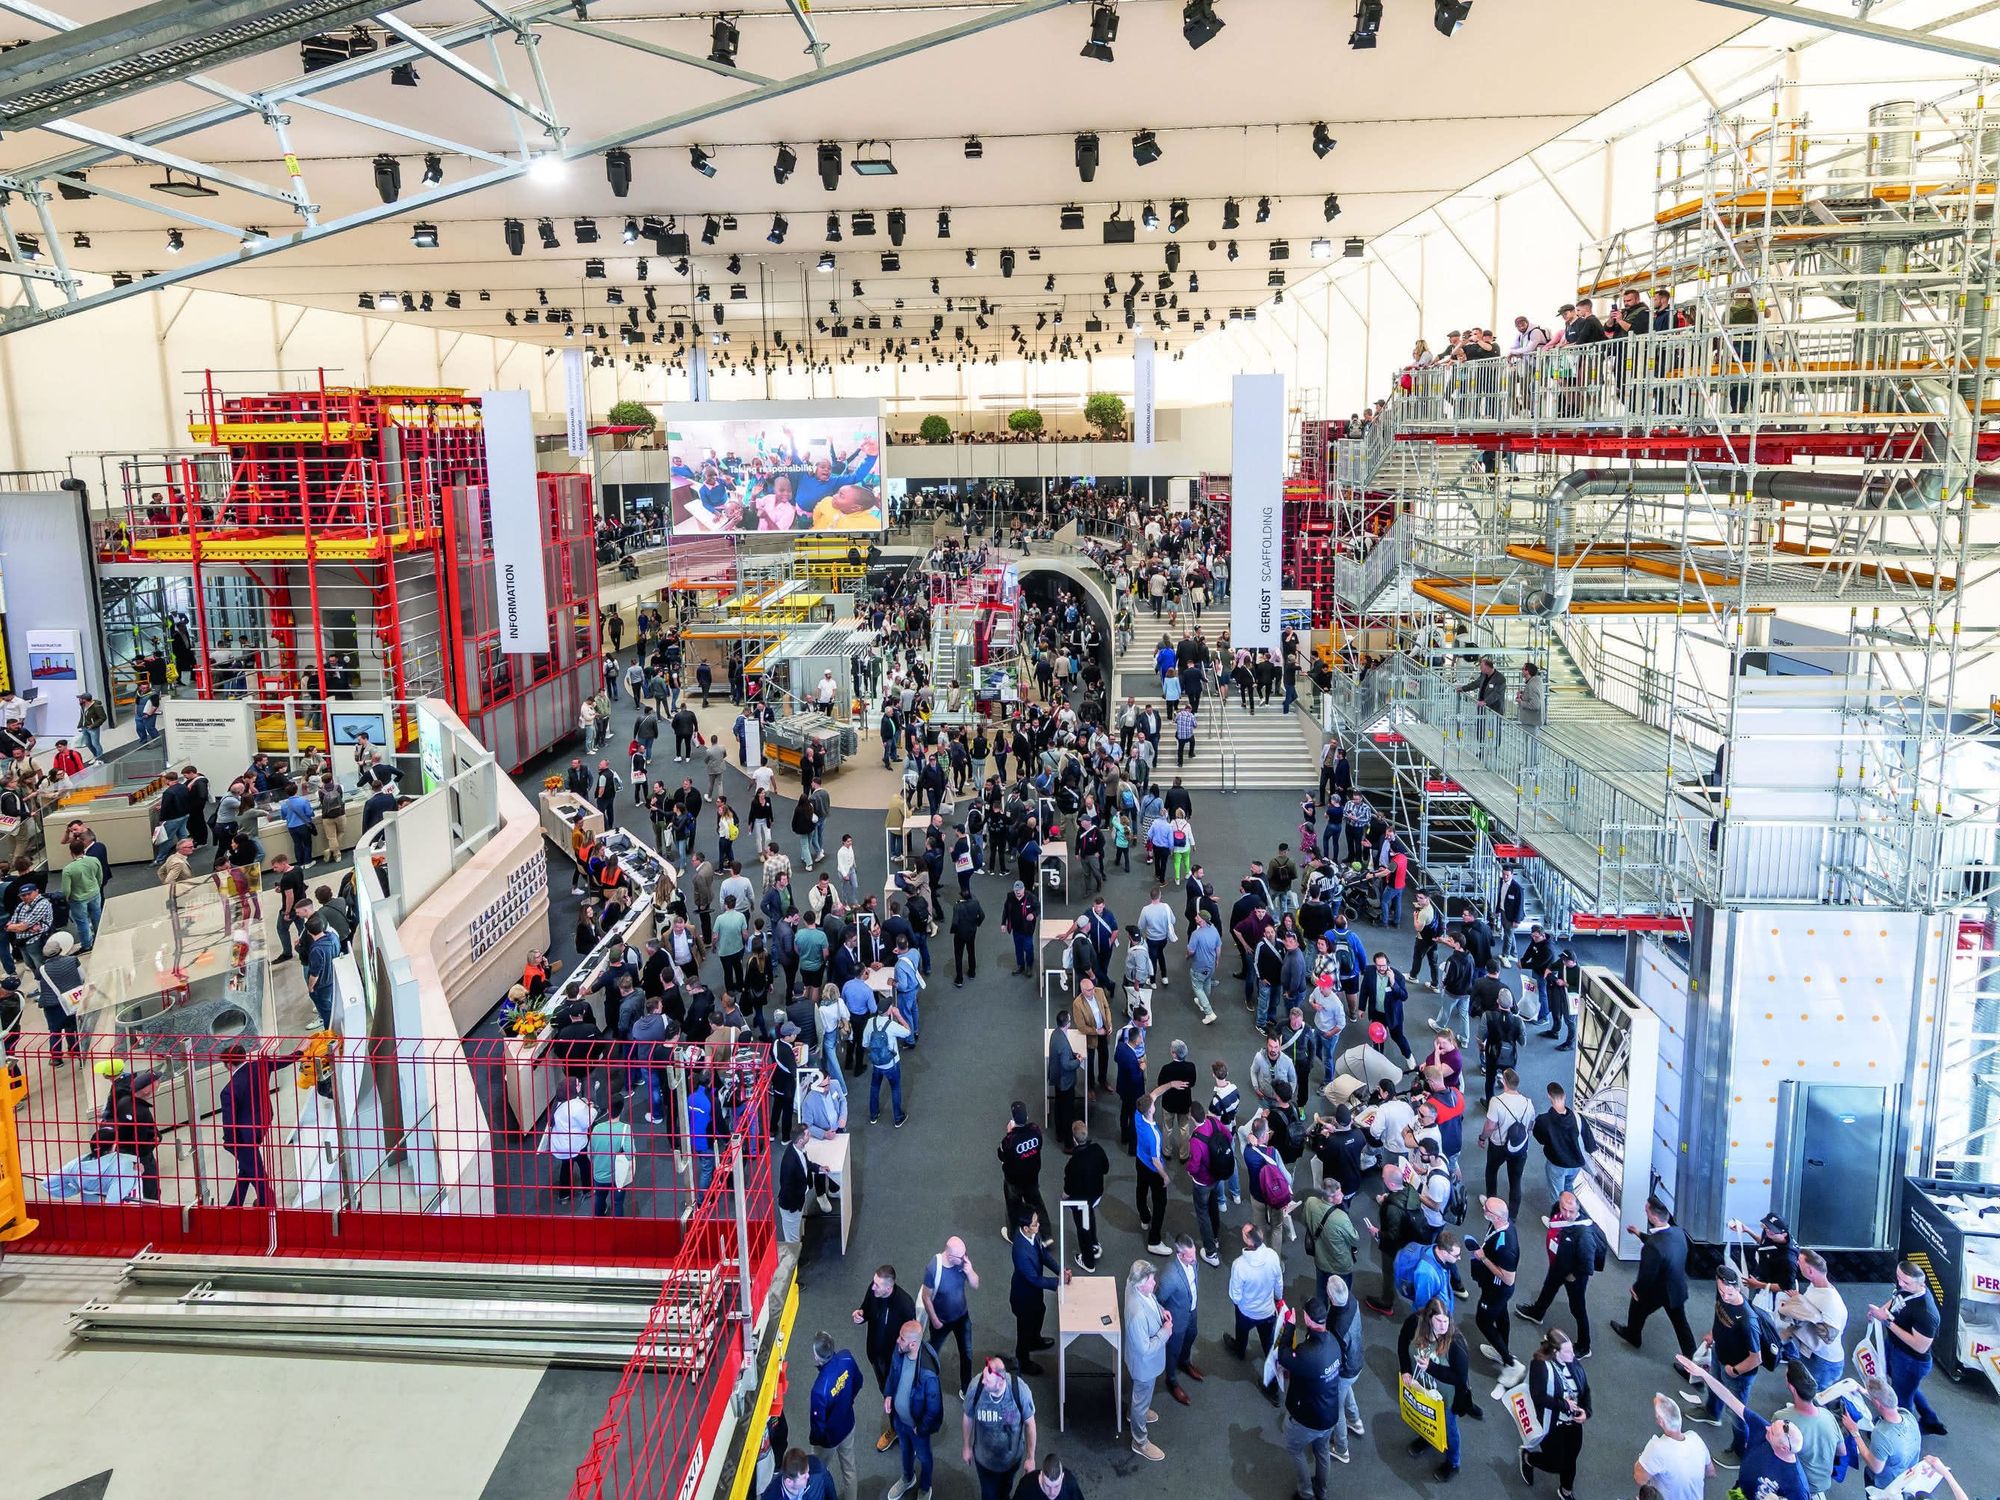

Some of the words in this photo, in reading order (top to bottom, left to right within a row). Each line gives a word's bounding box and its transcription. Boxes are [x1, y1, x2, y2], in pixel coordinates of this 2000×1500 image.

[729, 465, 757, 474] Taking
[759, 464, 818, 474] responsibility
[1262, 507, 1273, 582] SCAFFOLDING
[505, 564, 519, 639] INFORMATION
[1258, 588, 1271, 633] GERÜST
[1050, 871, 1060, 886] 5
[811, 1071, 824, 1093] 2
[1977, 1275, 2000, 1290] PER
[1861, 1353, 1876, 1375] PER
[1516, 1398, 1533, 1434] PERI
